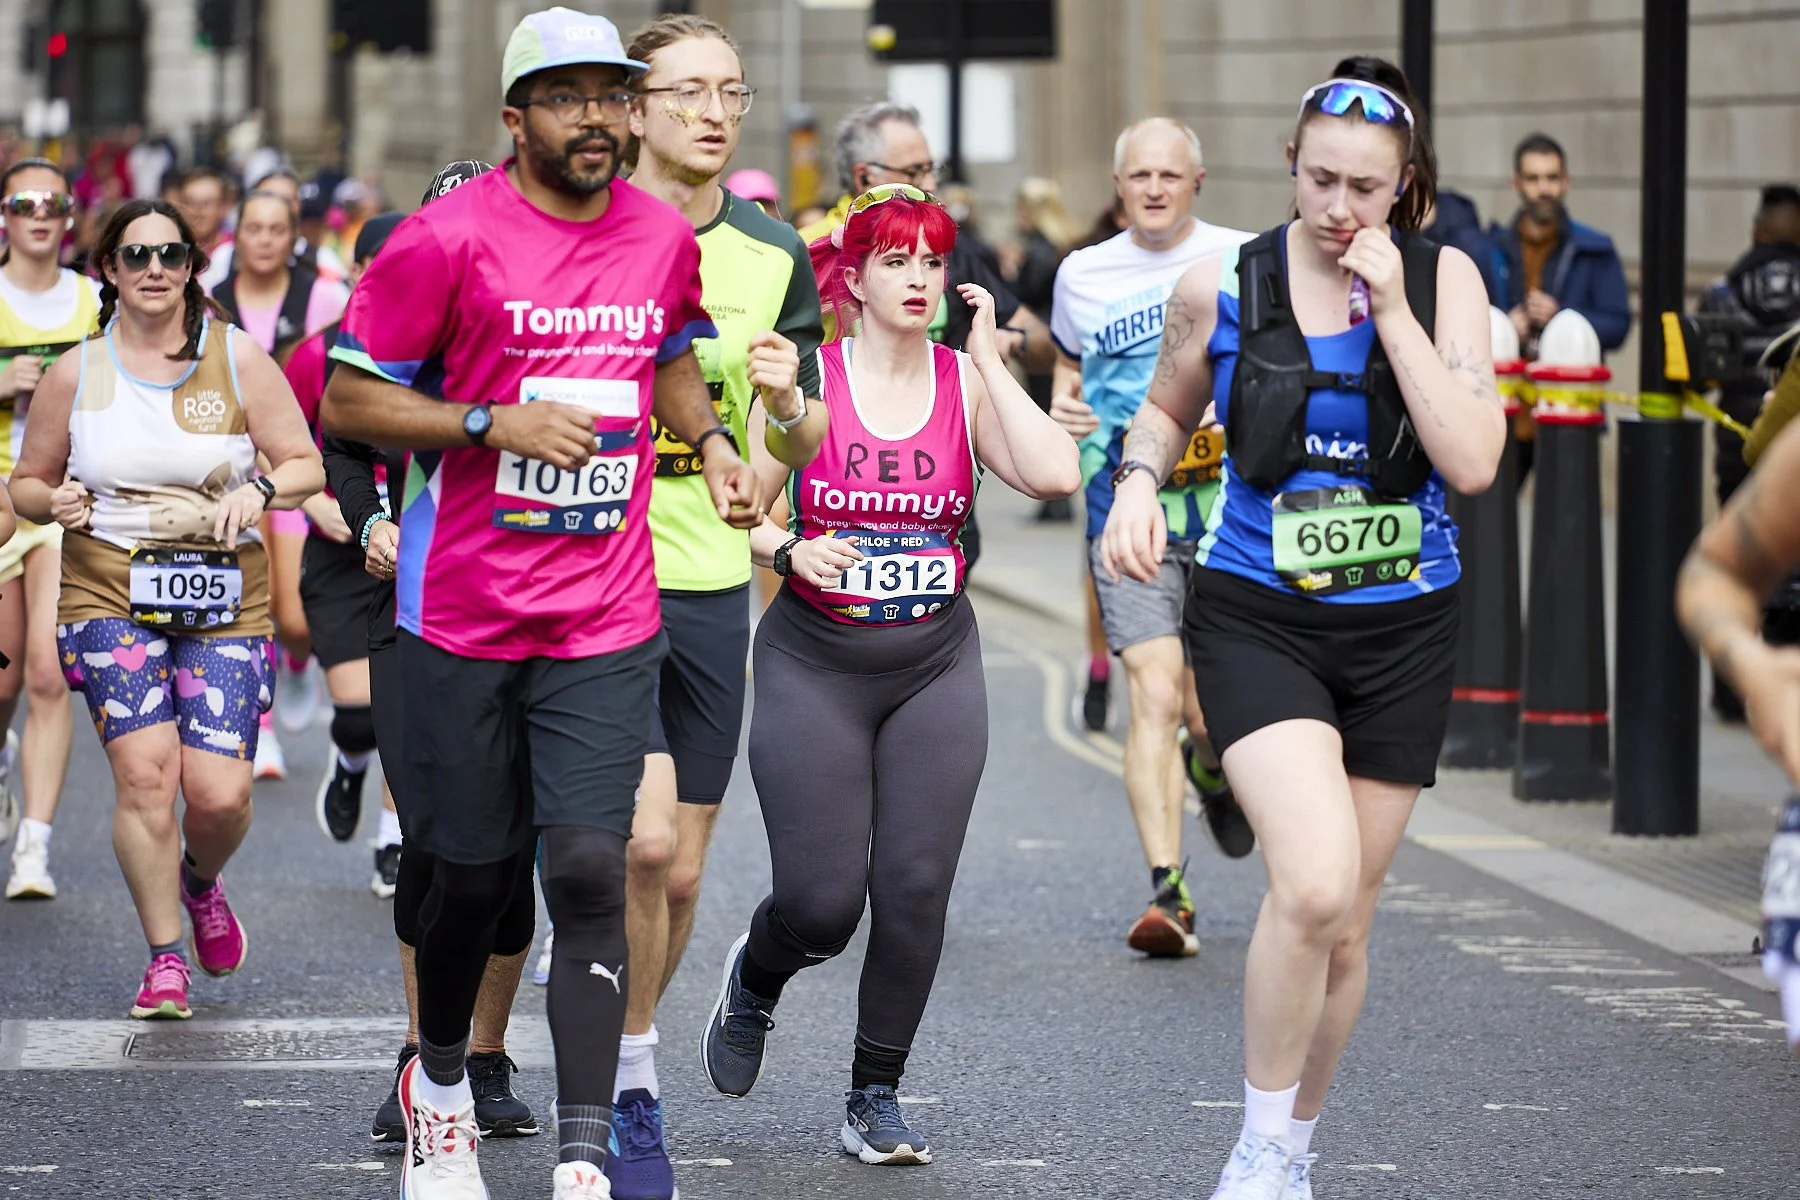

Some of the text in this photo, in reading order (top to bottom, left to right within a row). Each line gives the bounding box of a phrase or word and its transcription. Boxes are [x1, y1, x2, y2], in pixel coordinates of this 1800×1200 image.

[503, 299, 665, 341] Tommy's
[701, 304, 746, 314] ARATONA
[708, 312, 727, 320] ISA
[1095, 303, 1168, 355] MARA
[504, 347, 525, 357] The
[582, 344, 606, 356] and
[607, 343, 635, 359] baby
[184, 397, 226, 418] Roo
[845, 443, 936, 483] RED
[512, 457, 628, 497] 10163
[809, 478, 967, 520] Tommy's
[1333, 490, 1363, 505] ASH
[811, 515, 825, 526] The
[879, 522, 900, 531] and
[901, 522, 926, 532] baby
[1297, 514, 1400, 556] 6670
[901, 537, 924, 547] RED
[174, 552, 203, 563] LAURA
[150, 573, 226, 600] 1095
[840, 559, 948, 592] 11312
[412, 1105, 425, 1168] HOKA
